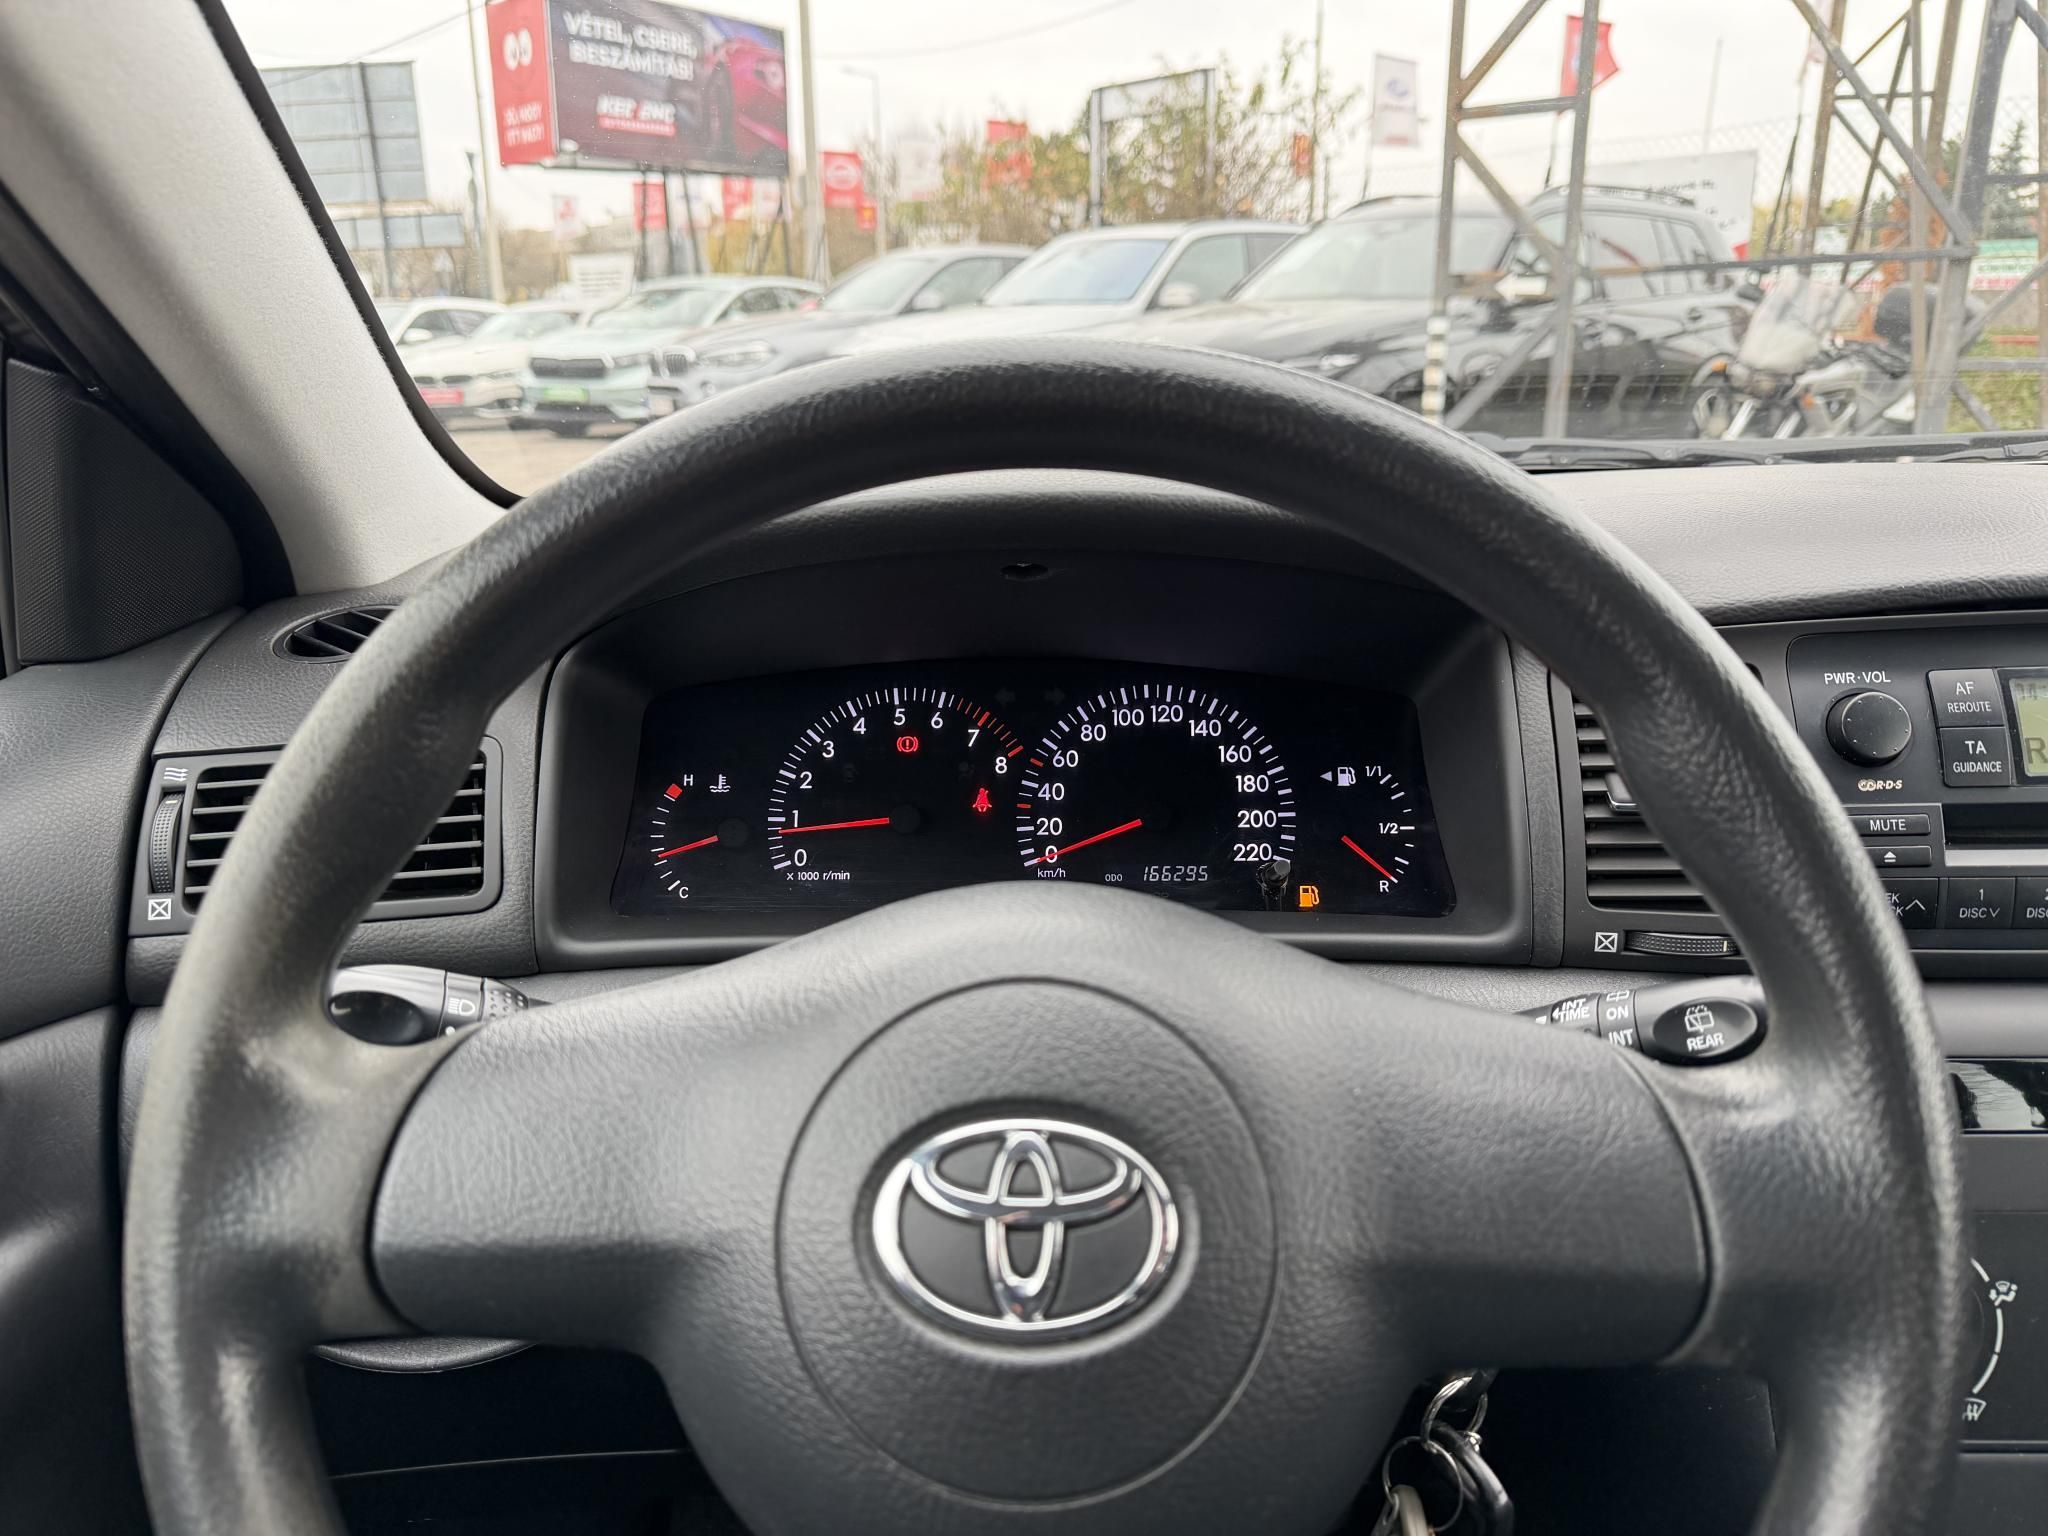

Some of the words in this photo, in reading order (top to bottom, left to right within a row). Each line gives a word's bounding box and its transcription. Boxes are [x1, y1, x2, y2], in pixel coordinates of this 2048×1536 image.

[1955, 681, 1975, 696] AF
[1150, 704, 1184, 723] 120
[1947, 701, 1992, 713] REROUTE
[852, 716, 867, 735] 4
[893, 708, 906, 726] 5
[930, 711, 944, 729] 6
[1111, 708, 1145, 727] 100
[1080, 723, 1107, 742] 80
[1188, 719, 1222, 737] 140
[967, 728, 980, 748] 7
[822, 740, 835, 759] 3
[1218, 744, 1252, 763] 160
[1965, 740, 1987, 755] TA
[994, 756, 1008, 774] 8
[1052, 749, 1079, 768] 60
[1953, 761, 2002, 773] GUIDANCE
[799, 770, 813, 789] 2
[1365, 765, 1382, 777] 1/1
[683, 774, 694, 787] H
[1235, 774, 1269, 793] 180
[1037, 782, 1065, 801] 40
[792, 809, 799, 828] 1
[1036, 817, 1063, 836] 20
[1237, 809, 1277, 828] 200
[1869, 819, 1907, 831] MUTE
[1378, 822, 1399, 835] 1/2
[794, 848, 808, 867] 0
[1044, 845, 1058, 864] 0
[1233, 842, 1272, 862] 220
[797, 871, 820, 881] 1000
[821, 870, 851, 881] r/min
[1037, 868, 1066, 878] km/h
[1104, 873, 1123, 882] ODO
[1143, 865, 1208, 882] 166295
[678, 886, 689, 899] C
[1379, 879, 1390, 893] R
[1978, 888, 1984, 901] 1
[1959, 907, 1988, 919] DISC
[1561, 998, 1587, 1009] INT
[1606, 1004, 1629, 1020] ON
[1558, 1006, 1590, 1024] TIME
[1608, 1028, 1634, 1046] INT
[1686, 1031, 1725, 1052] REAR
